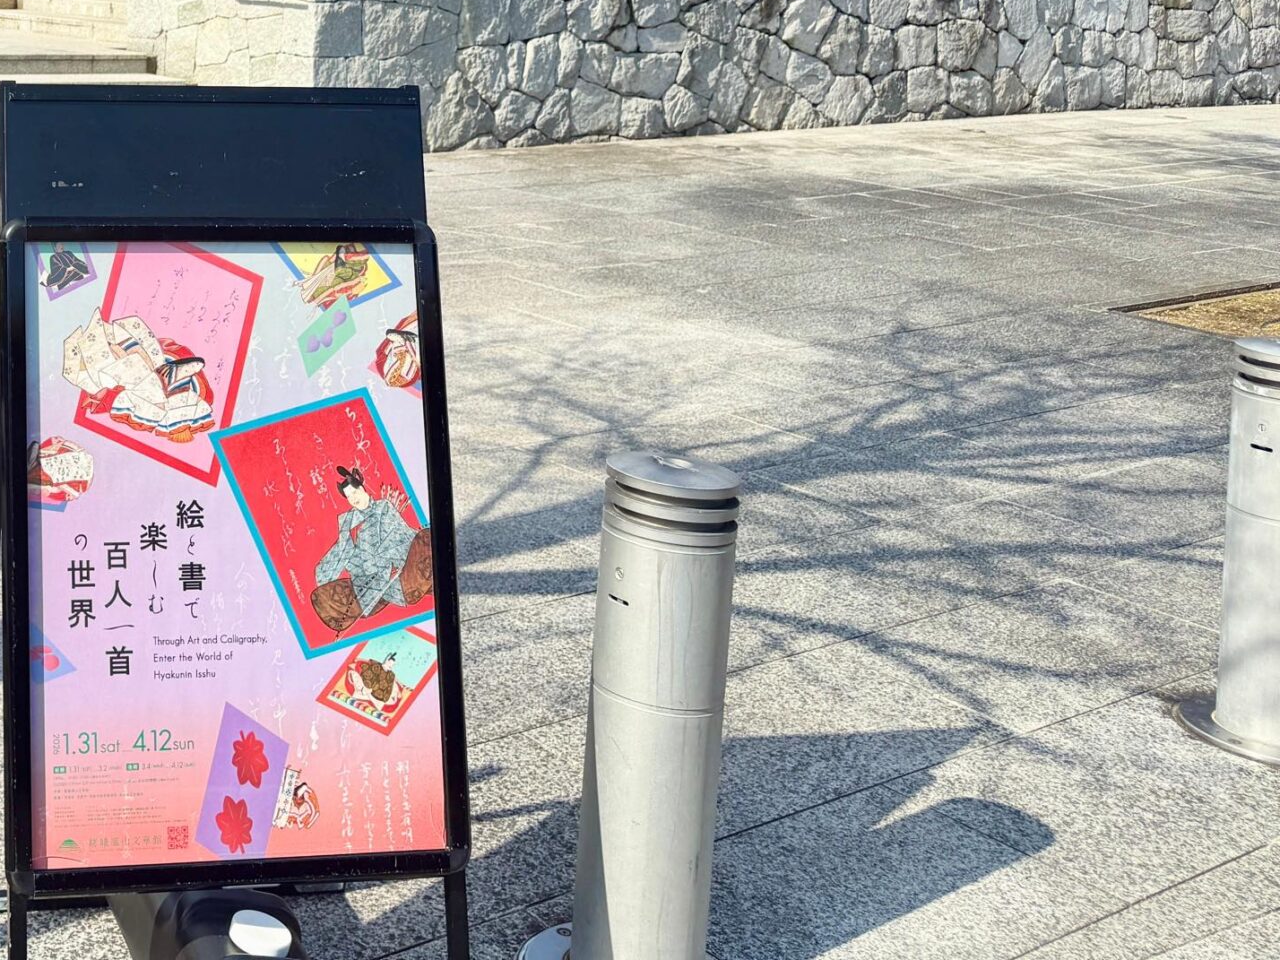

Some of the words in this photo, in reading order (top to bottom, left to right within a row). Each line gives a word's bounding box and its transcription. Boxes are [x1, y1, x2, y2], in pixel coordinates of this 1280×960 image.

[67, 533, 96, 628] の世界
[140, 522, 168, 614] 楽しむ
[176, 499, 206, 619] 絵と書で
[103, 541, 135, 676] 百人一首
[153, 635, 185, 647] Through
[187, 635, 200, 645] Art
[202, 634, 218, 645] and
[153, 653, 176, 663] Enter
[179, 652, 193, 662] the
[196, 651, 222, 661] World
[224, 650, 234, 660] of
[153, 670, 193, 682] Hyakunin
[195, 668, 216, 679] Isshu
